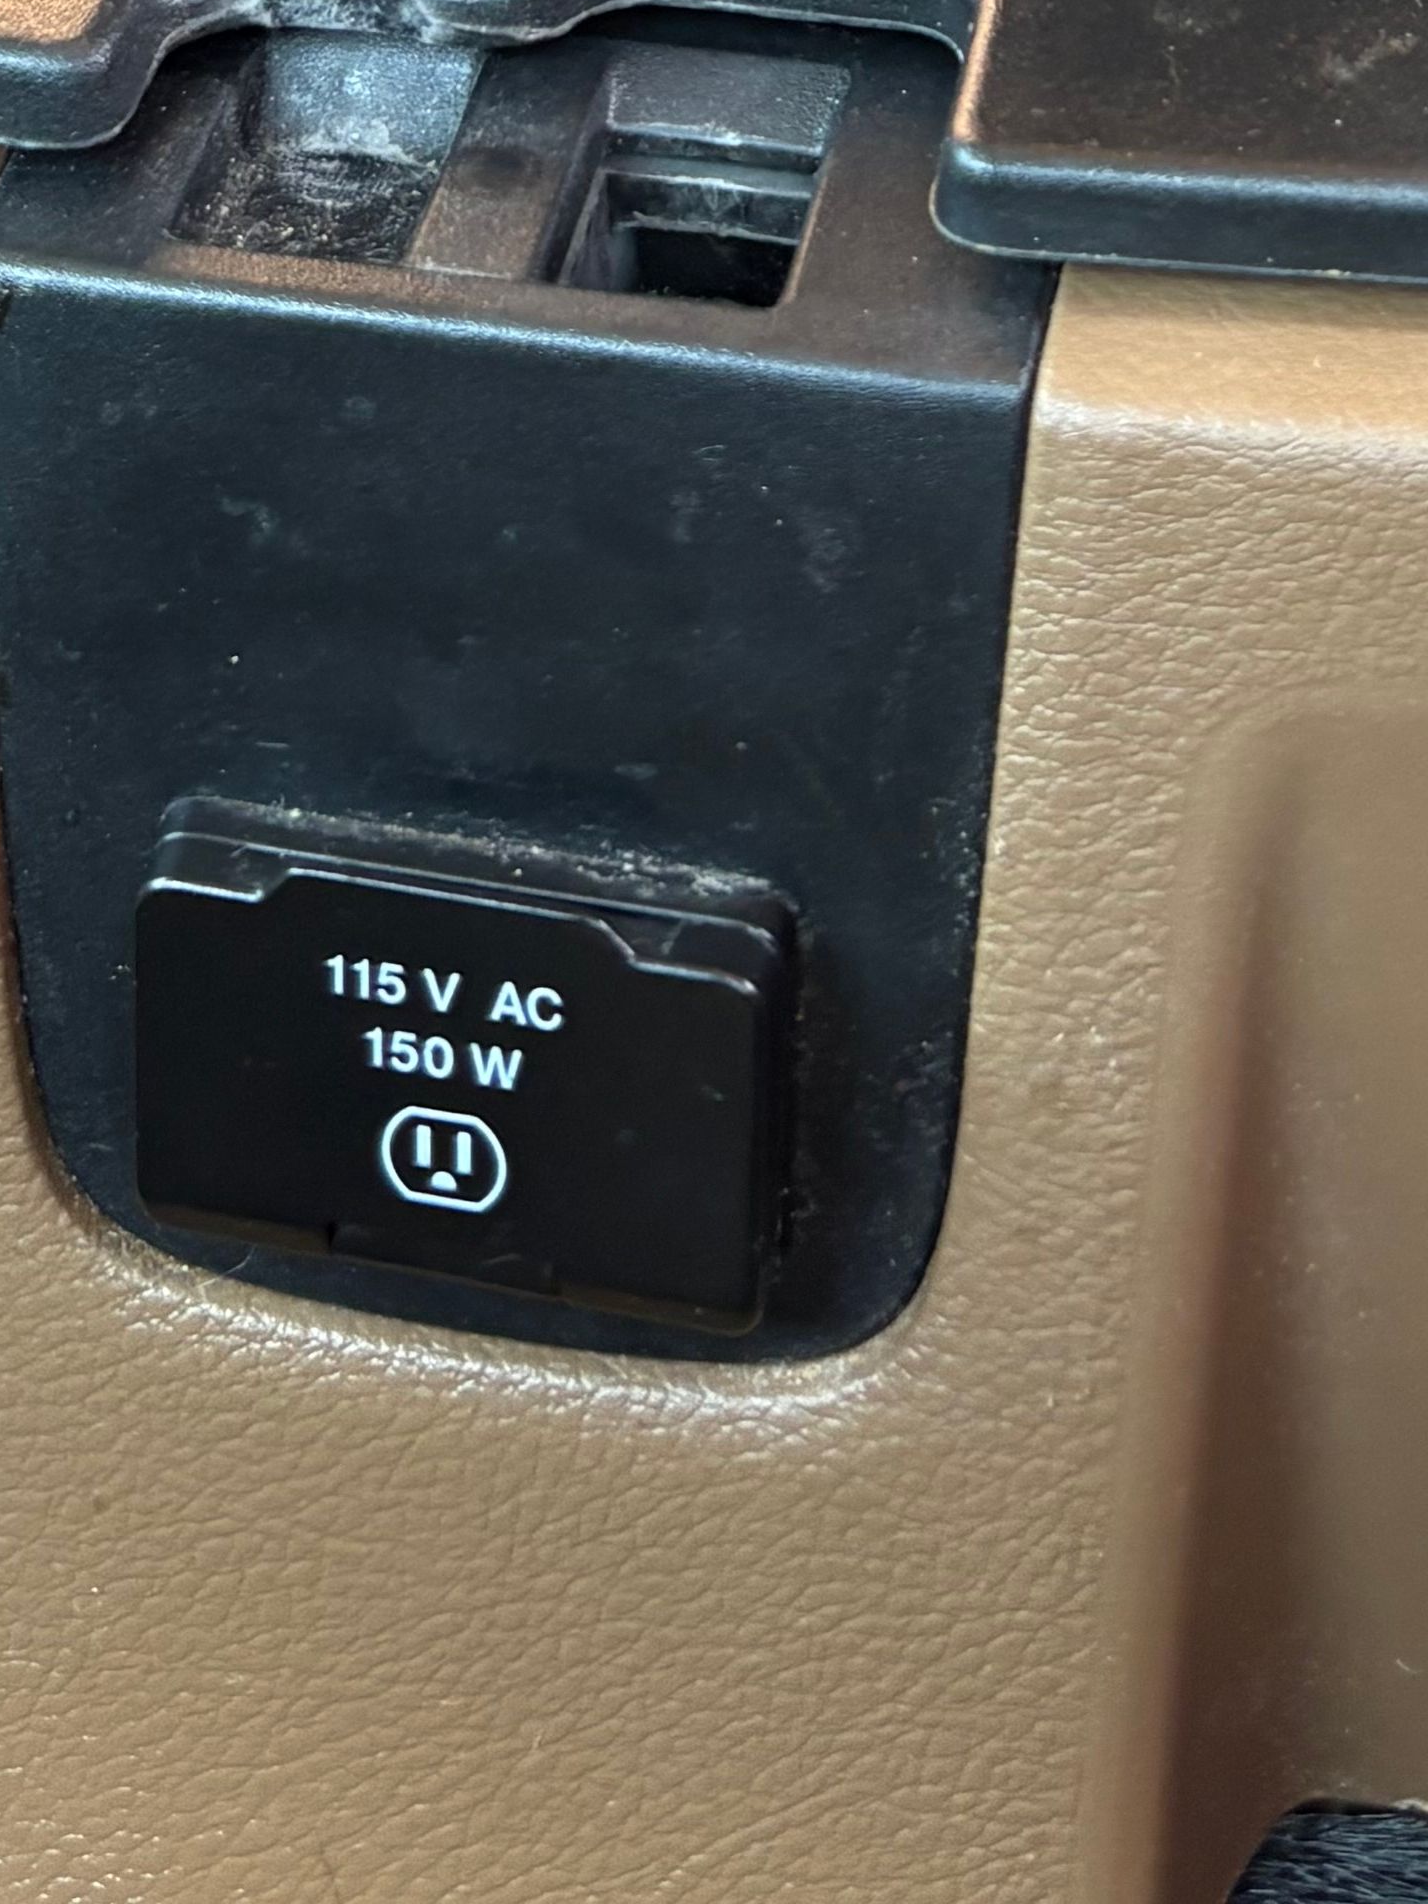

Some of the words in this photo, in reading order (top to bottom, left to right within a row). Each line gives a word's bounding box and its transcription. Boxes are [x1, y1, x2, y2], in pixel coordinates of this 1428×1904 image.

[324, 953, 407, 1005] 115
[422, 967, 461, 1013] V
[489, 981, 565, 1032] AC
[363, 1026, 454, 1079] 150
[470, 1042, 522, 1090] W
